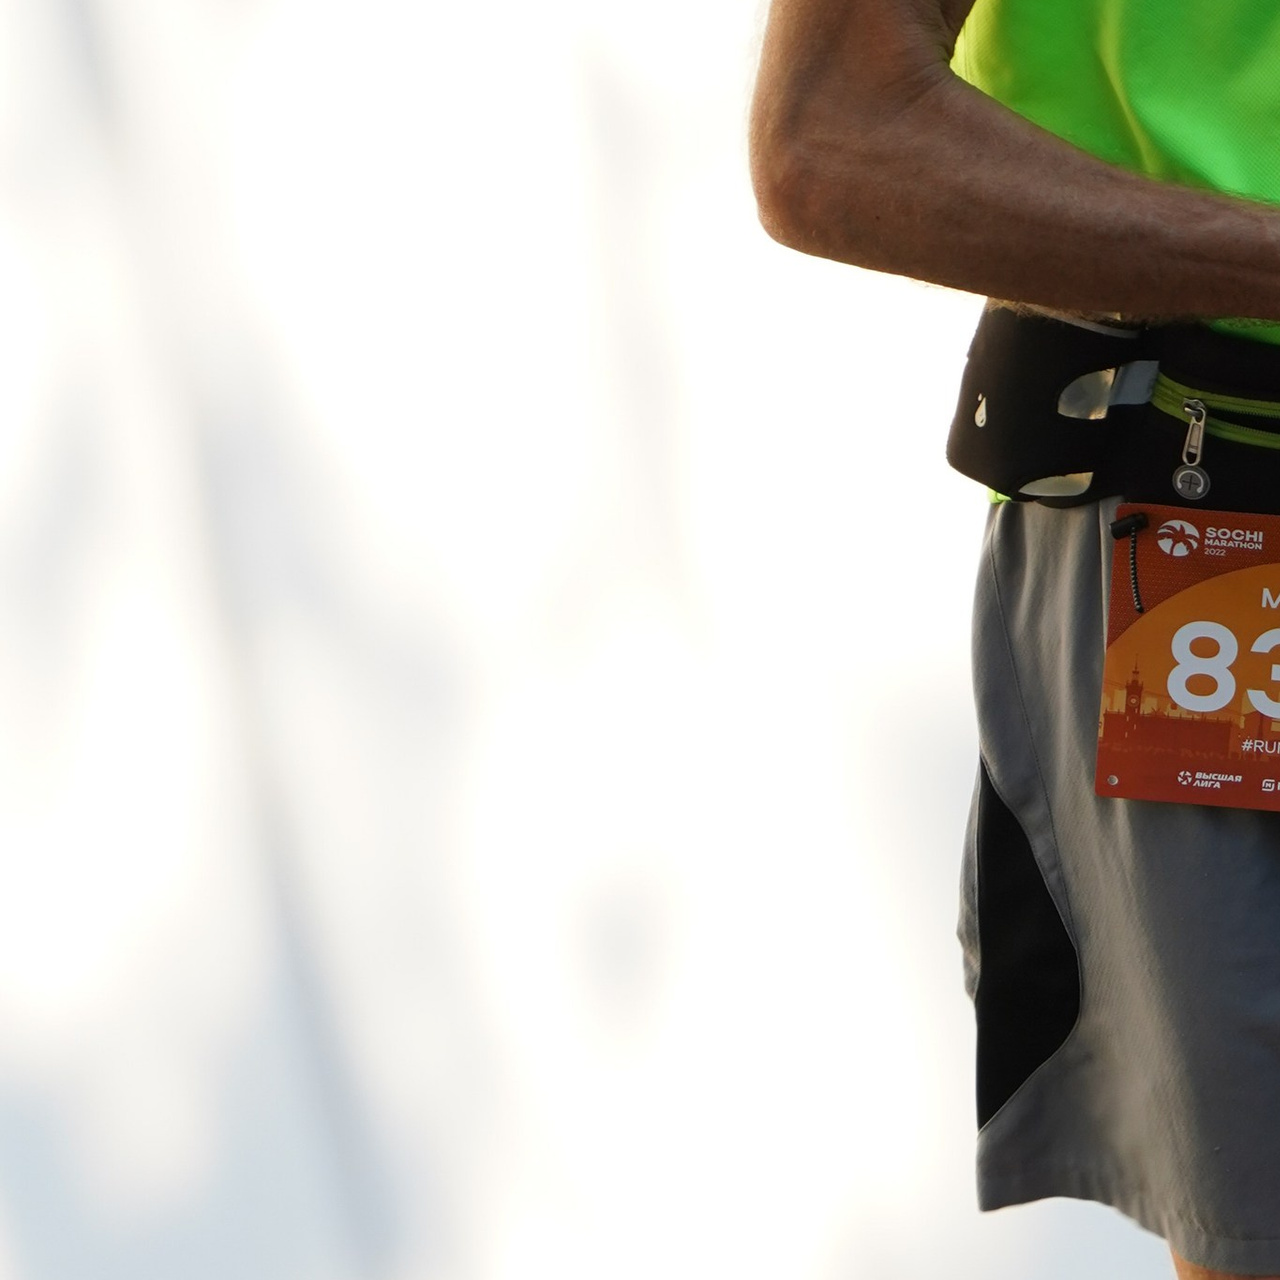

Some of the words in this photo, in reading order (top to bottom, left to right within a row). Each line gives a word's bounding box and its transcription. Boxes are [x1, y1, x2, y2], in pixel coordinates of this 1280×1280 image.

[1204, 526, 1264, 541] SOCHI
[1203, 539, 1263, 551] MARATHON
[1203, 548, 1226, 556] 2022
[1195, 771, 1242, 783] ВЫСШАЯ
[1192, 779, 1222, 789] ЛИГА
